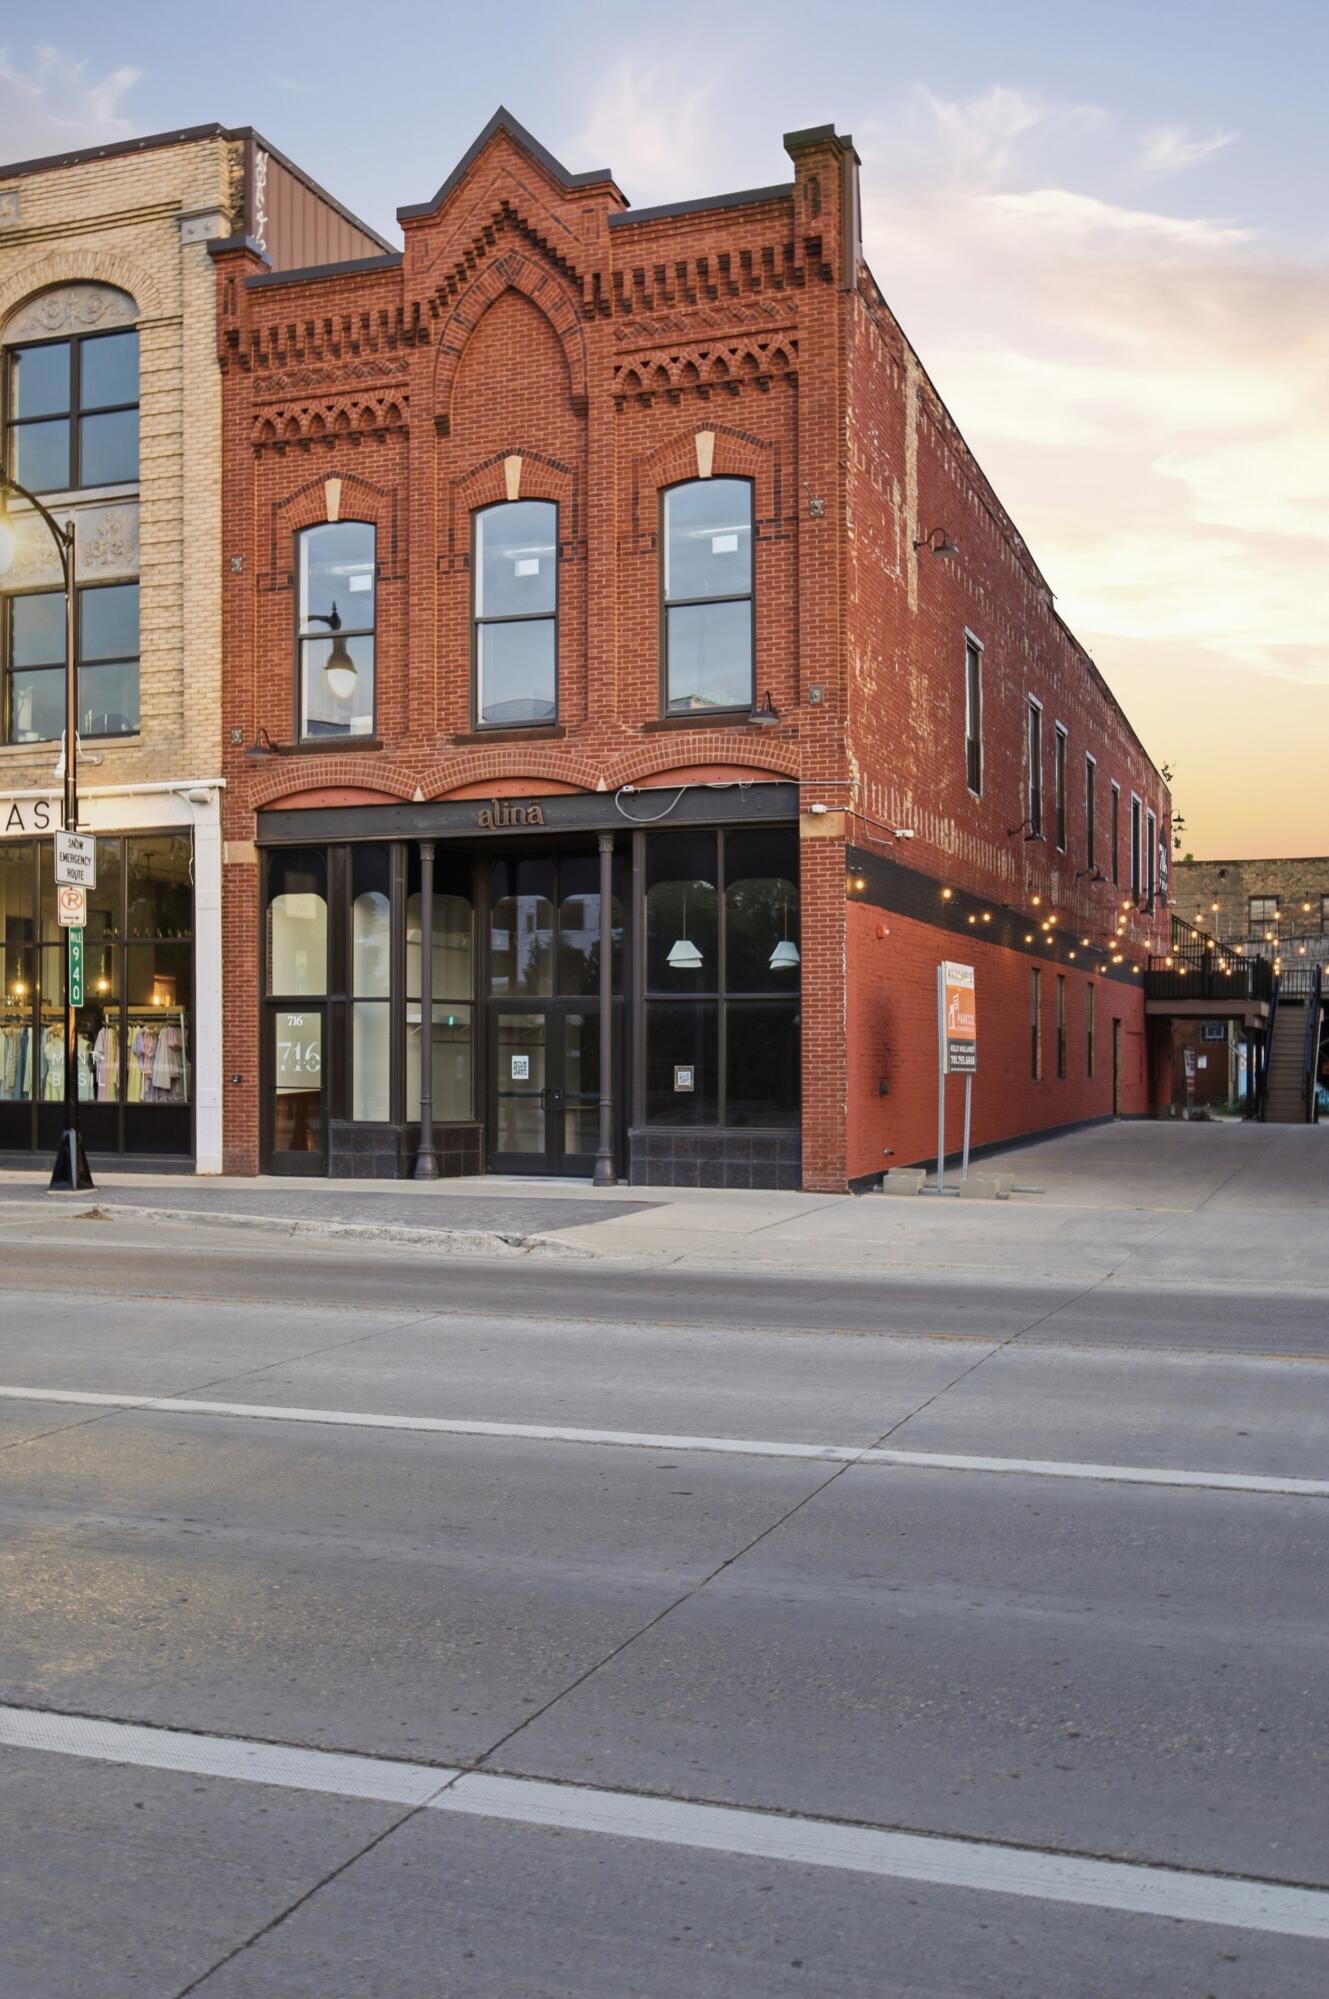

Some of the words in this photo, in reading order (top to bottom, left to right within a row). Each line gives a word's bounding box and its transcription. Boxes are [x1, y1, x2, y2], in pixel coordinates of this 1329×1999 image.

[67, 838, 84, 850] SNOW
[59, 851, 92, 867] EMERGENCY
[66, 868, 84, 881] ROUTE
[287, 1015, 304, 1026] 716
[52, 1051, 98, 1065] MNT
[277, 1041, 321, 1073] 716
[52, 1071, 106, 1087] BSIL
